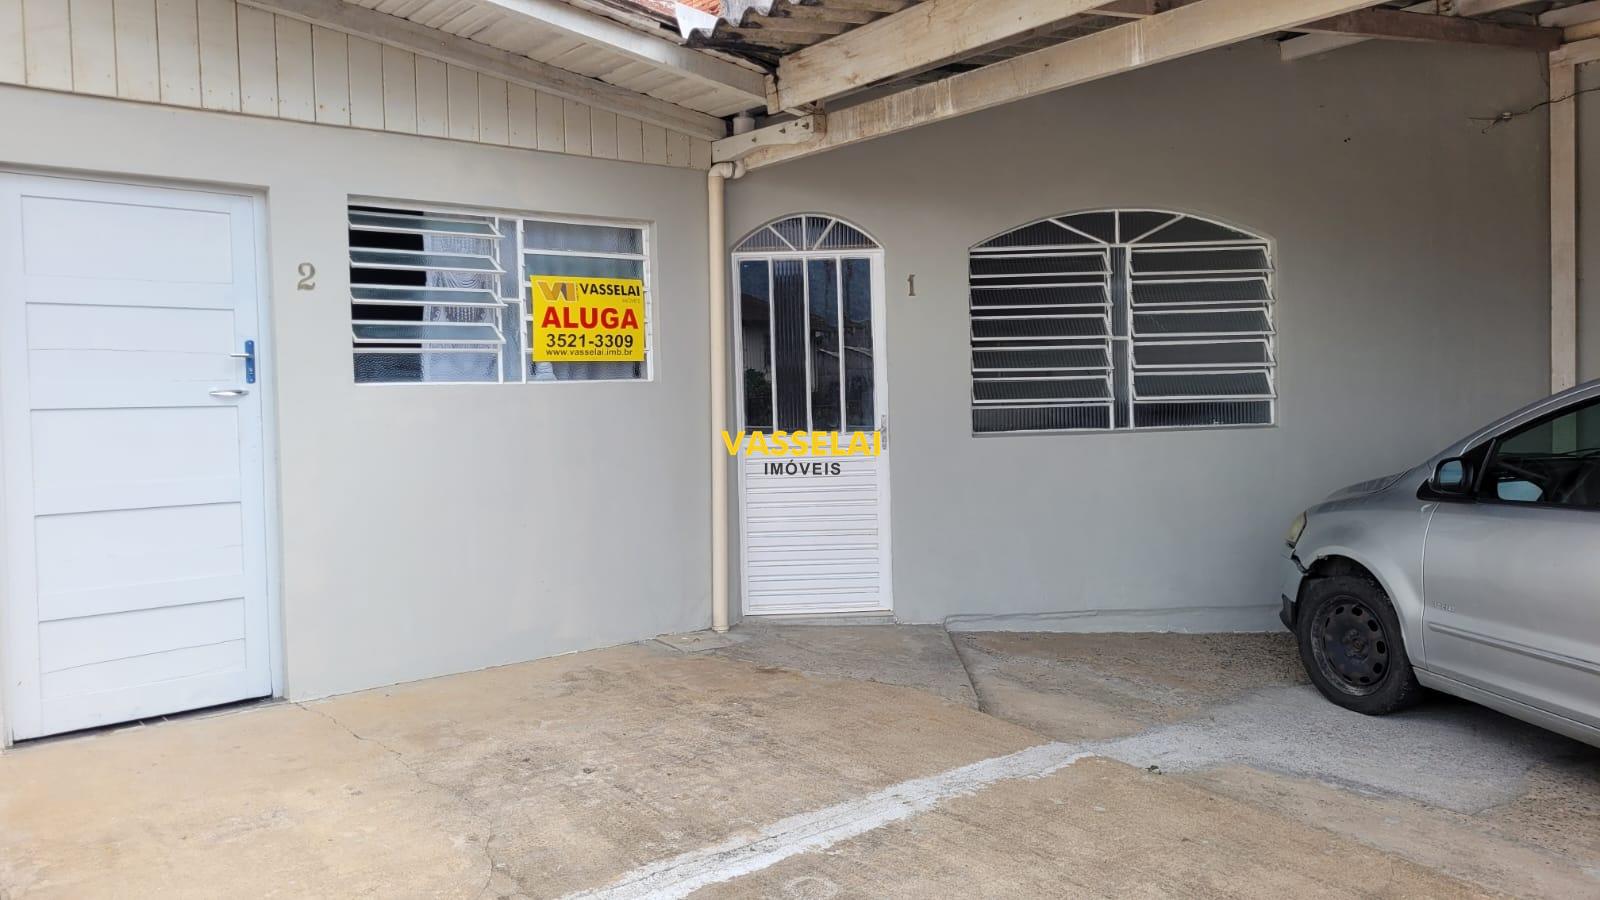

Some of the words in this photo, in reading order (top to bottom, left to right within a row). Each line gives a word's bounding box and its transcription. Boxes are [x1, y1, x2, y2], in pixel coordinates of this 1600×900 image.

[298, 262, 316, 291] 2
[907, 274, 916, 297] 1
[579, 283, 640, 296] VASSELAI
[541, 306, 639, 330] ALUGA
[546, 333, 634, 348] 3521-3309
